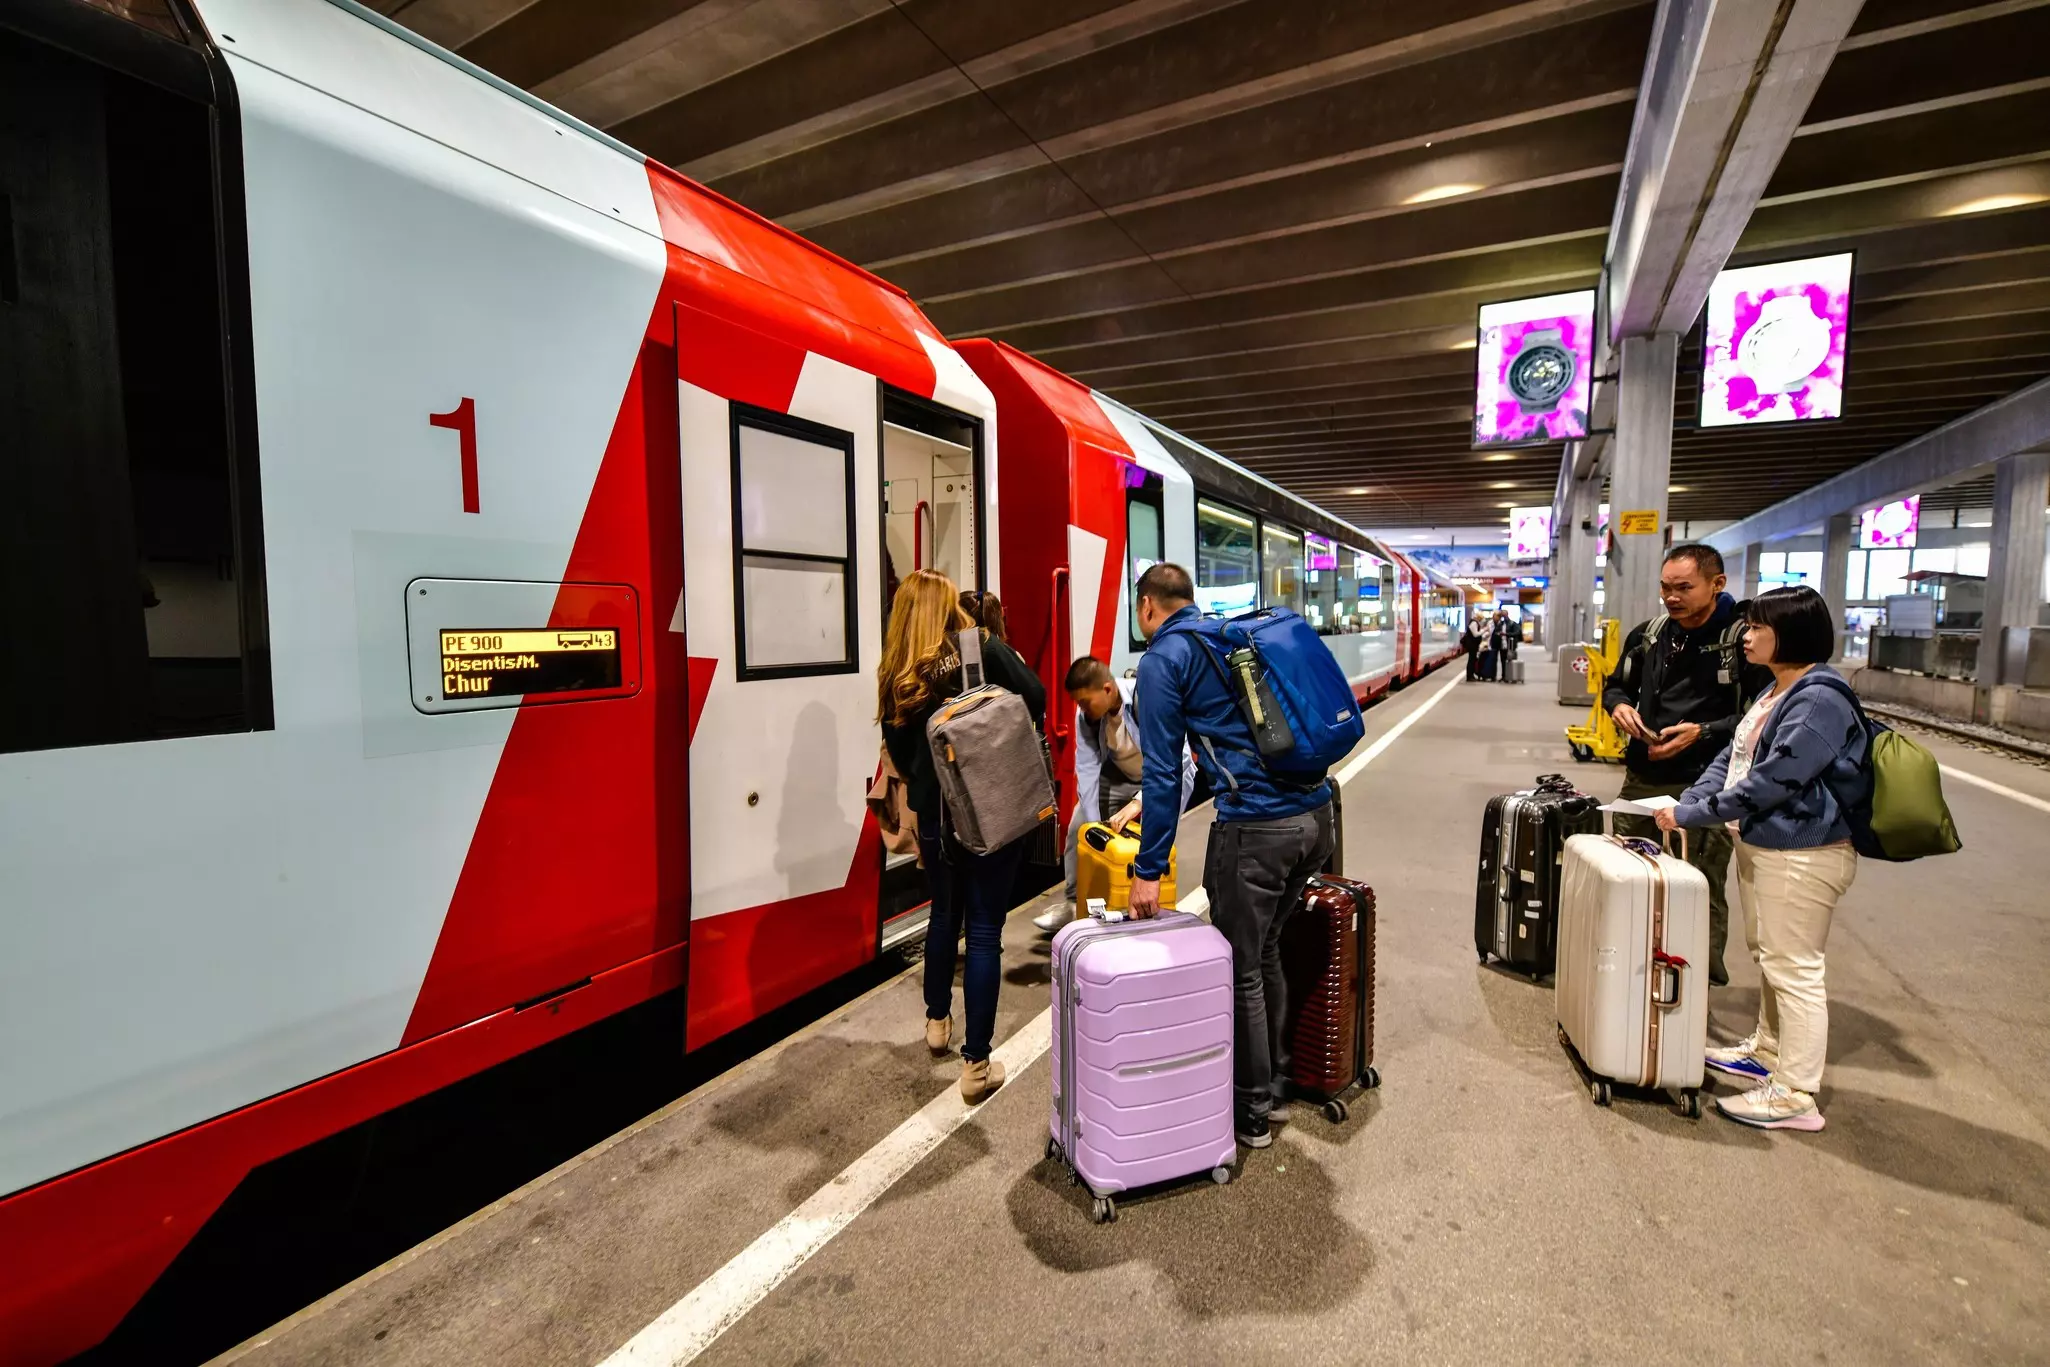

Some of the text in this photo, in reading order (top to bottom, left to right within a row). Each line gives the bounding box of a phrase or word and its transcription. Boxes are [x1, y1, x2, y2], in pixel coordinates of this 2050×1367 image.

[429, 396, 480, 514] 1
[445, 634, 612, 651] PE 900 43
[443, 655, 540, 673] Disentis/M.
[444, 674, 493, 694] Chur
